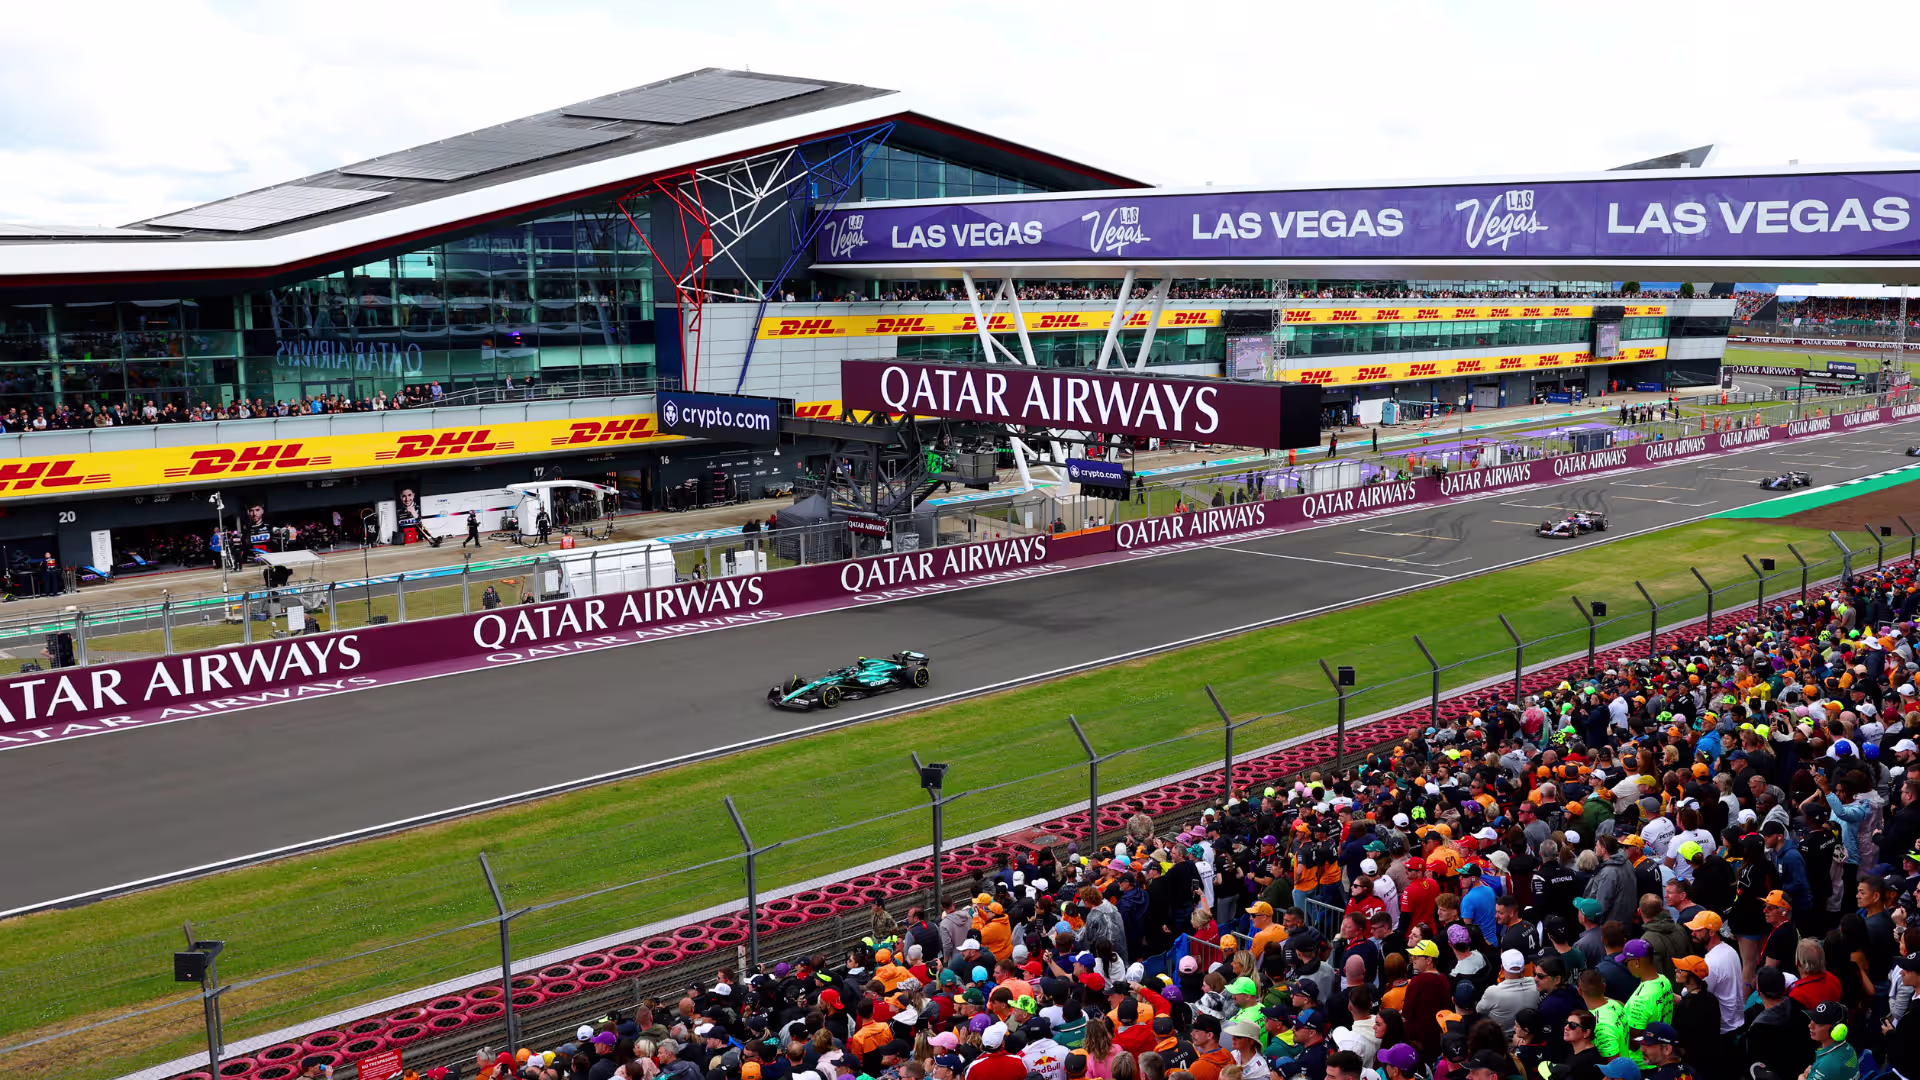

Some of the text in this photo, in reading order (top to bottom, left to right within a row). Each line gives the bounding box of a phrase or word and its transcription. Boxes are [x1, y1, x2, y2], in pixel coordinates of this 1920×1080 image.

[1456, 191, 1549, 250] LAS Vegas
[1608, 197, 1910, 234] LAS VEGAS
[1083, 207, 1151, 255] LAS Vegas
[1193, 209, 1403, 239] LAS VEGAS
[825, 214, 868, 257] LAS Vegas
[892, 221, 1042, 248] LAS VEGAS
[1174, 312, 1207, 324] DHL
[1286, 311, 1311, 321] DHL
[1332, 311, 1357, 320] DHL
[1377, 310, 1400, 320] DHL
[1417, 310, 1439, 318] DHL
[1456, 309, 1475, 318] DHL
[1491, 308, 1509, 317] DHL
[1523, 308, 1540, 316] DHL
[1554, 308, 1570, 316] DHL
[1648, 307, 1660, 315] DHL
[779, 320, 835, 335] DHL
[875, 318, 925, 332] DHL
[1040, 315, 1081, 328] DHL
[1539, 355, 1559, 366] DHL
[1638, 350, 1654, 359] DHL
[1409, 364, 1436, 376] DHL
[1456, 360, 1480, 372] DHL
[1500, 358, 1522, 368] DHL
[1300, 370, 1334, 384] DHL
[1358, 367, 1386, 380] DHL
[1732, 365, 1796, 376] QATAR AIRWAYS
[880, 366, 1219, 434] QATAR AIRWAYS
[682, 407, 770, 431] crypto.com
[1844, 410, 1880, 427] QATAR AIRWAYS
[1892, 405, 1906, 419] QATAR
[569, 418, 655, 443] DHL
[1788, 417, 1830, 436] QATAR AIRWAYS
[397, 430, 496, 458] DHL
[1720, 427, 1770, 448] QATAR AIRWAYS
[1646, 443, 1672, 461] QATAR
[1674, 437, 1705, 455] AIRWAYS
[190, 443, 309, 475] DHL
[661, 456, 669, 464] 16
[1554, 455, 1588, 476] QATAR
[1590, 449, 1626, 470] AIRWAYS
[0, 460, 84, 491] HL
[534, 467, 544, 478] 17
[1081, 470, 1121, 479] crypto.com
[1441, 464, 1530, 495] QATAR AIRWAYS
[1302, 478, 1416, 519] QATAR AIRWAYS
[59, 511, 76, 523] 20
[865, 524, 885, 532] AIRWAYS
[1116, 504, 1265, 548] QATAR AIRWAYS
[840, 536, 1046, 592] QATAR AIRWAYS
[854, 563, 1066, 601] QATAR AIRWAYS
[473, 577, 764, 650] QATAR AIRWAYS
[486, 610, 783, 663] QATAR AIRWAYS
[144, 635, 361, 701] AIRWAYS
[0, 676, 378, 742] ATAR AIRWAYS
[1654, 868, 1660, 882] 4
[1528, 934, 1535, 949] 4
[369, 1056, 398, 1067] TRESPASSING
[1171, 1051, 1188, 1064] NORRIS
[1047, 1062, 1060, 1072] Bull
